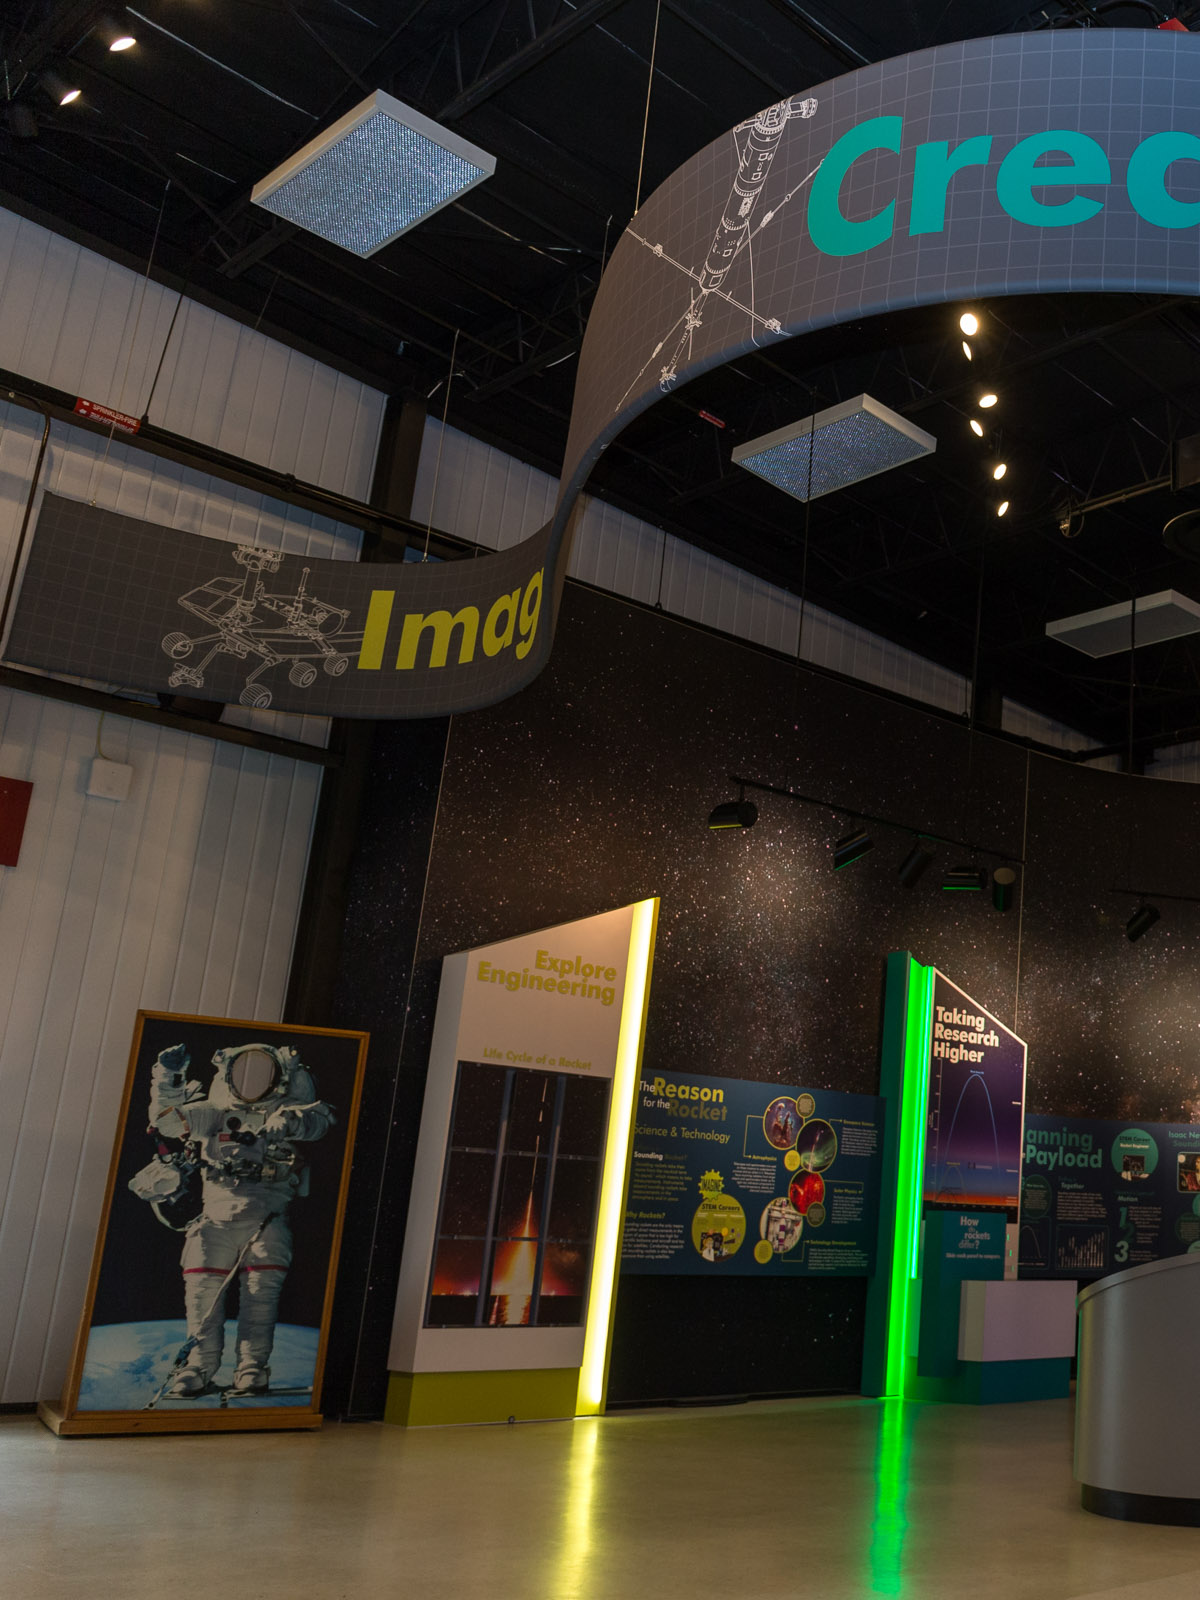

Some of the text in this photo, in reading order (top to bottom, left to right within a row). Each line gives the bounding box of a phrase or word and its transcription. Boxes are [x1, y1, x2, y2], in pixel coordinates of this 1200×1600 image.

[357, 567, 544, 670] Imag
[535, 949, 617, 982] Explore
[477, 961, 615, 1006] Engineering
[936, 1005, 985, 1032] Taking
[934, 1022, 1000, 1047] Research
[484, 1048, 503, 1058] Life
[506, 1050, 532, 1064] Cycle
[536, 1054, 548, 1065] of
[559, 1056, 592, 1070] Rocket
[933, 1041, 985, 1064] Higher
[639, 1076, 724, 1103] The Reason
[643, 1096, 728, 1121] for the Rocket
[633, 1124, 731, 1144] Science & Technology
[1168, 1131, 1187, 1139] Isaac
[633, 1151, 663, 1161] Sounding
[1026, 1144, 1102, 1170] Payload
[701, 1203, 740, 1212] STEM Careers
[960, 1216, 979, 1226] How
[964, 1231, 991, 1240] rockets
[1114, 1240, 1129, 1263] 3
